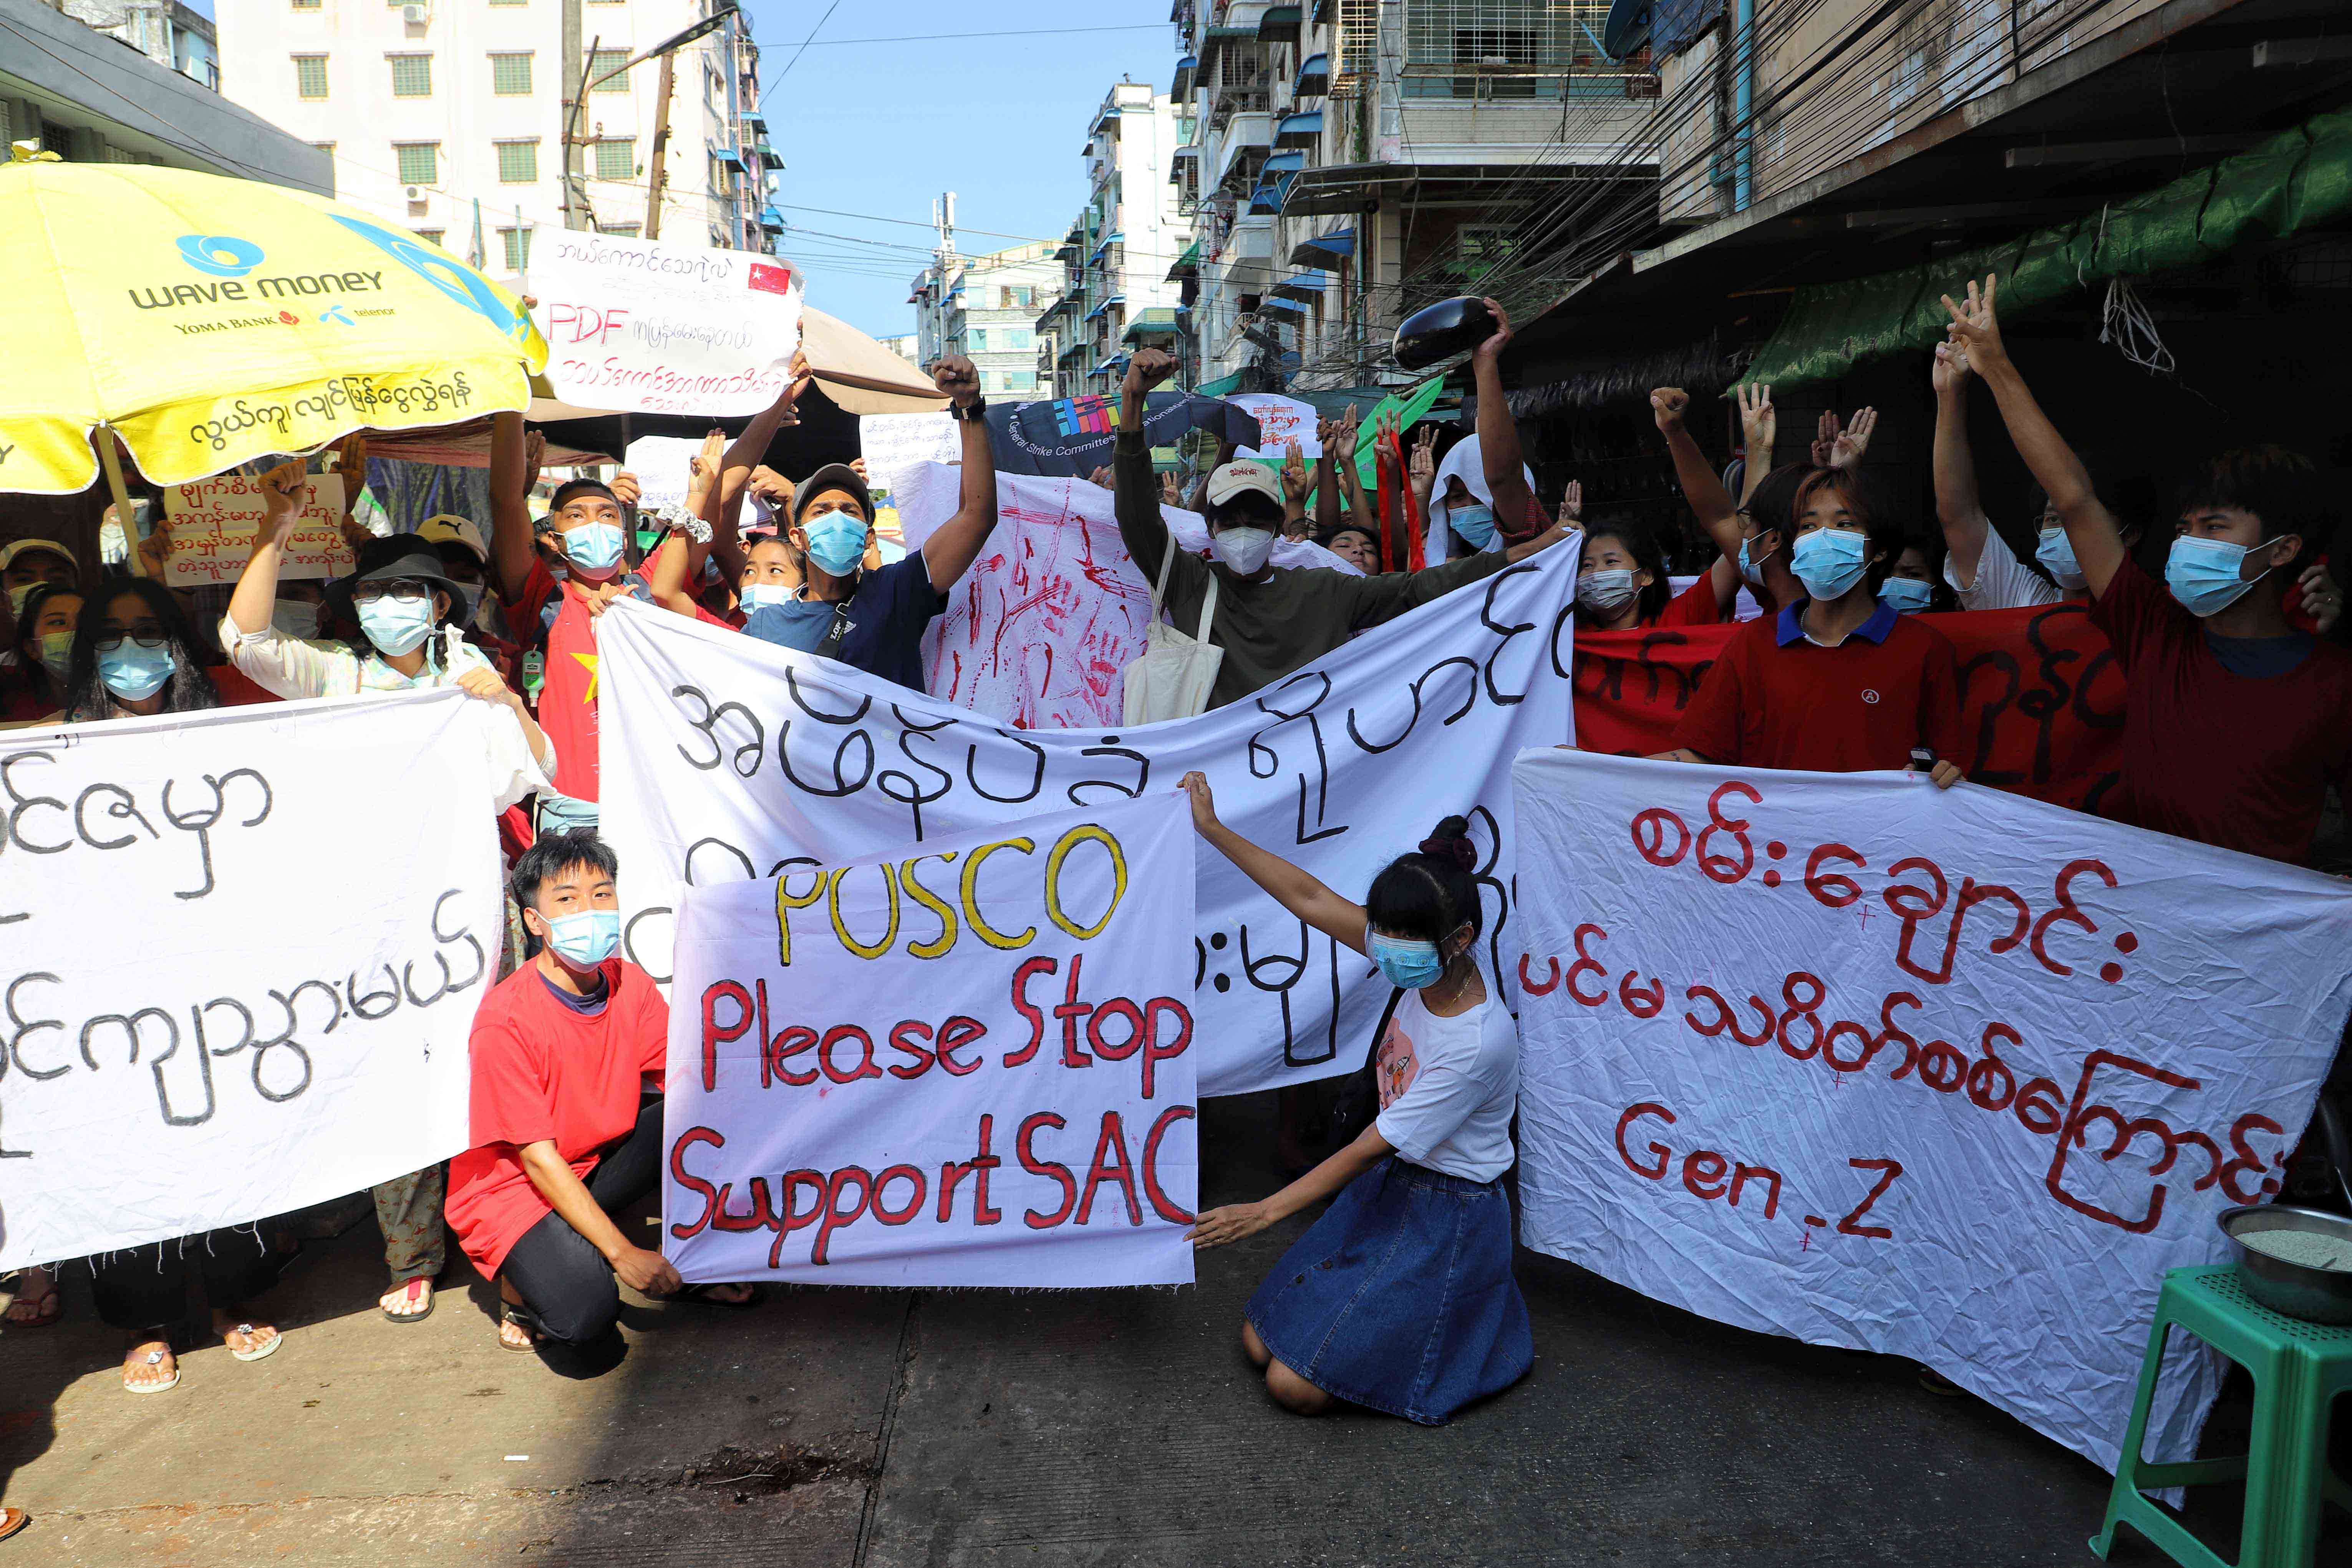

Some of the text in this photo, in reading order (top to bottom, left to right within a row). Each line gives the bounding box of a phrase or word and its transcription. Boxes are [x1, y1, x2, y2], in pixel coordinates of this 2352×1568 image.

[174, 316, 277, 335] YOMA BANK
[354, 306, 395, 317] telenor
[547, 303, 631, 346] PDF
[1008, 398, 1187, 457] General Strike Committee ationalities
[775, 823, 1127, 967] POSCO
[1631, 780, 2138, 984] စမ်းချောင်း
[701, 978, 988, 1093] Please
[1003, 954, 1195, 1100] Stop
[670, 1106, 1197, 1269] Support SAC
